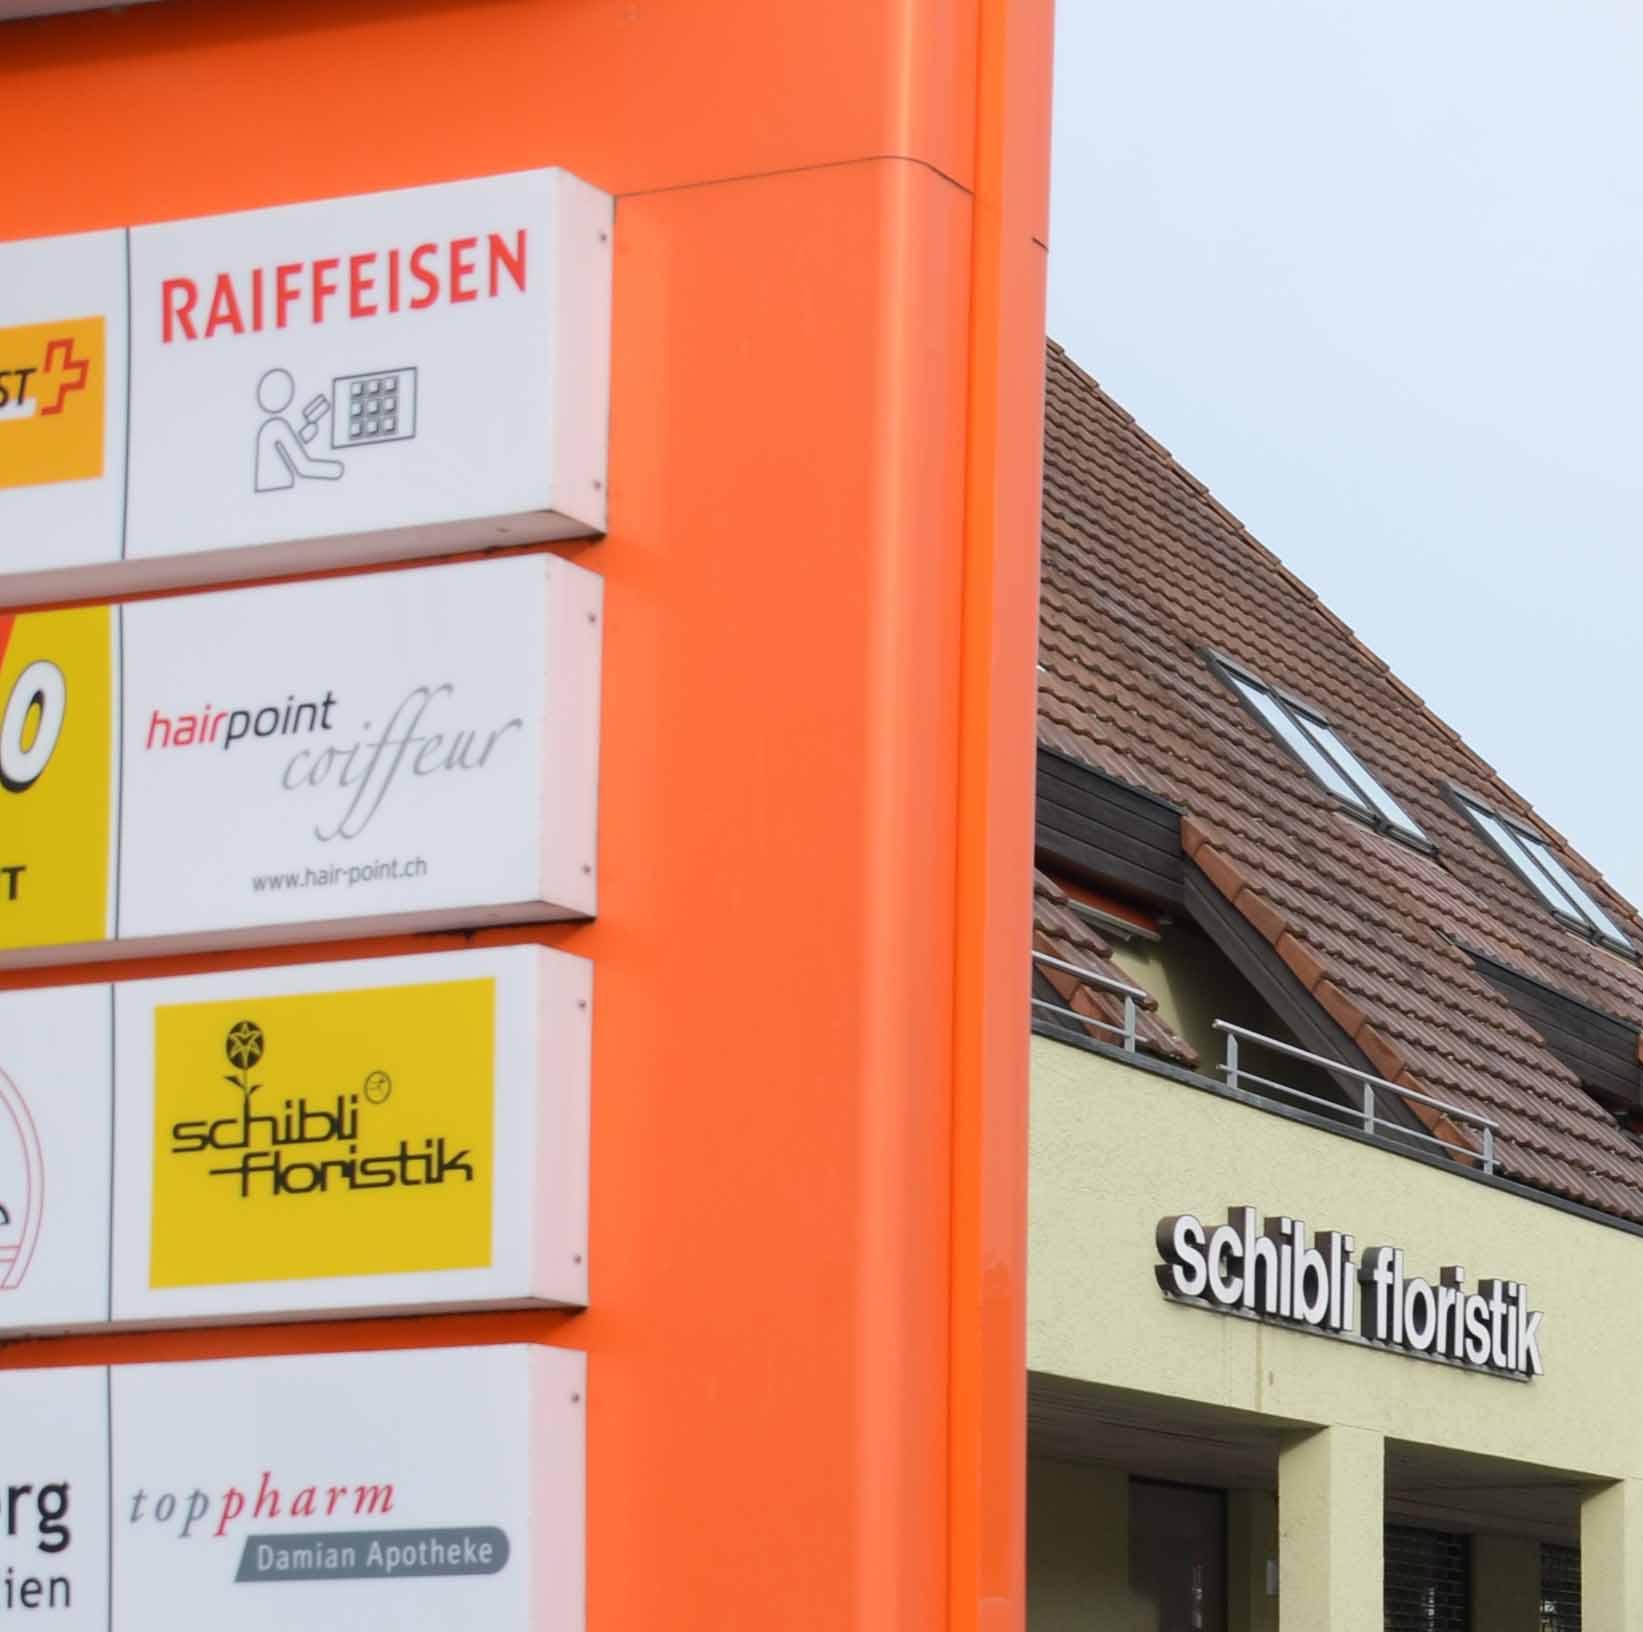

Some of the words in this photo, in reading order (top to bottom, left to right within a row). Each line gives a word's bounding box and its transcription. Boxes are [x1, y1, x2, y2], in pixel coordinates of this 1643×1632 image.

[161, 228, 529, 344] RAIFFEISEN
[145, 690, 337, 750] hairpoint
[281, 682, 523, 842] coiffeur
[251, 856, 428, 894] www.hair-point.ch
[171, 1094, 359, 1154] schibli
[209, 1137, 474, 1198] floristik
[1155, 1205, 1357, 1332] schibli
[1357, 1245, 1545, 1377] floristik
[0, 1481, 71, 1554] rg
[129, 1472, 396, 1537] toppharm
[256, 1541, 357, 1572] Damian
[366, 1535, 494, 1576] Apotheke
